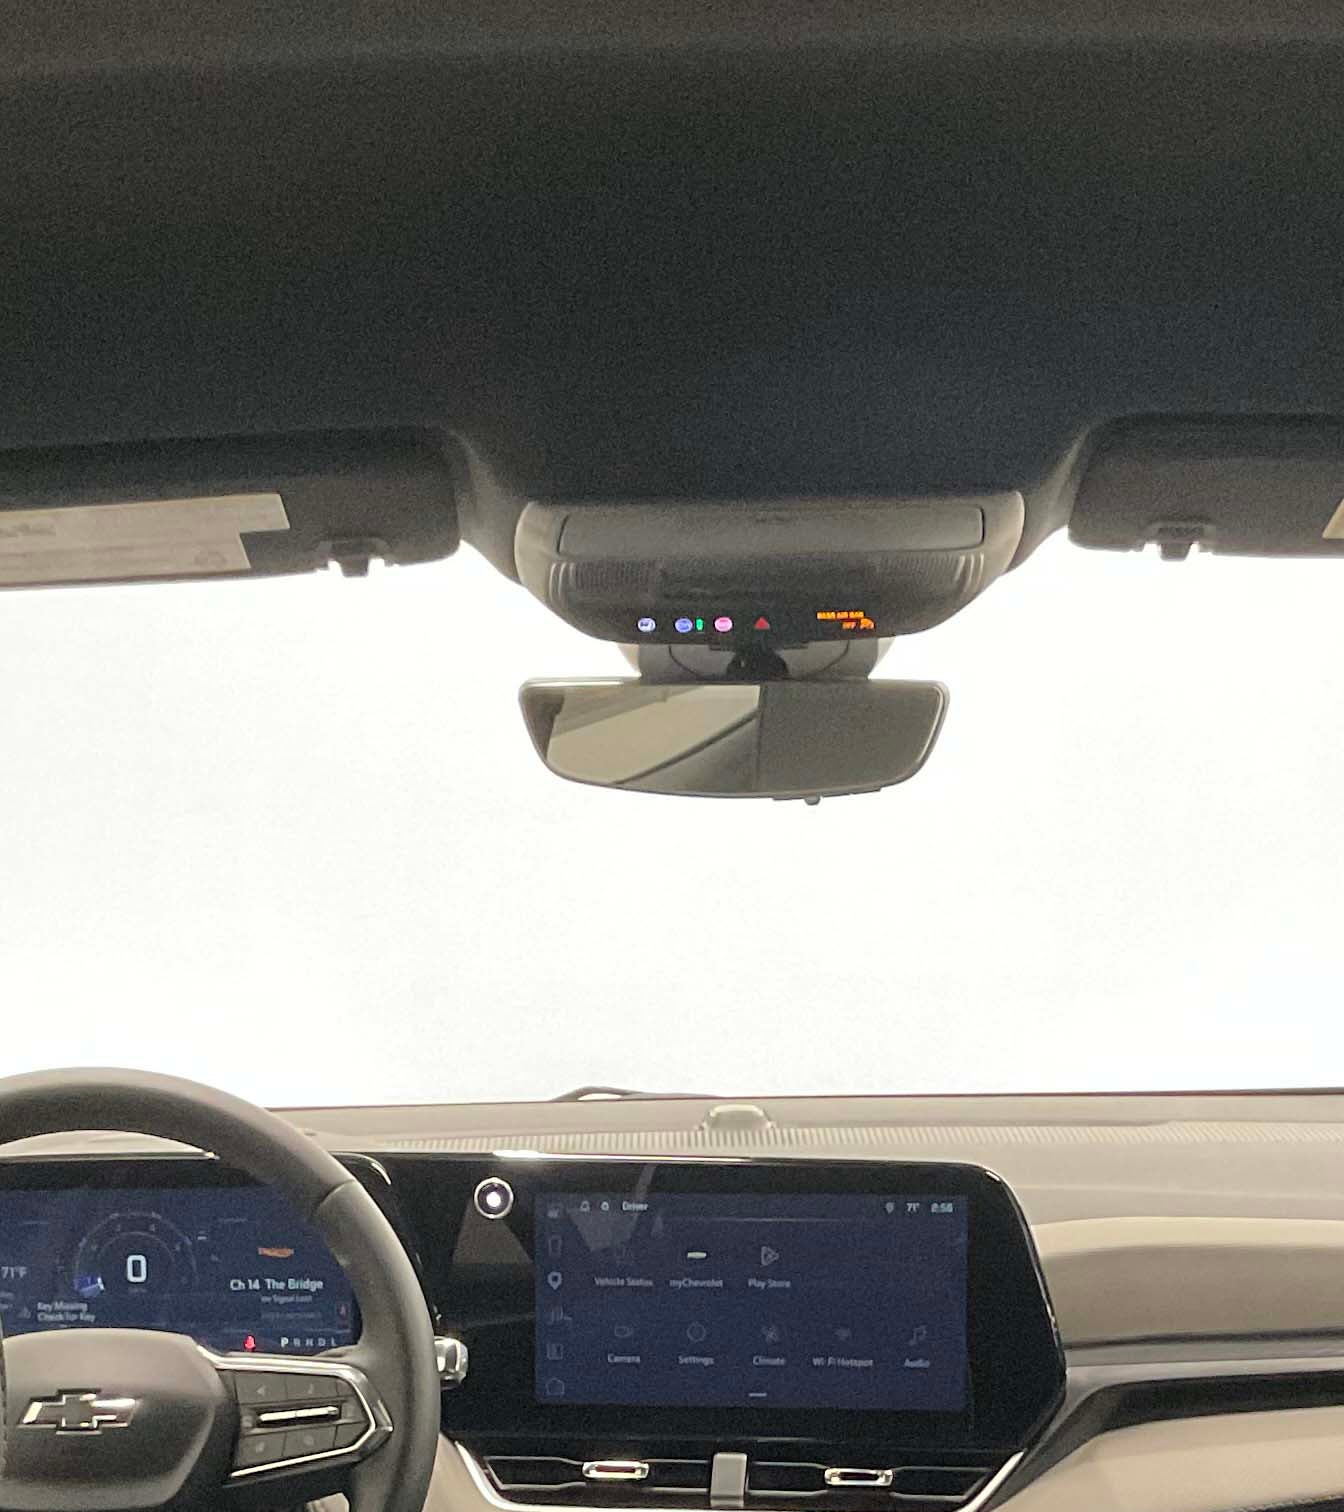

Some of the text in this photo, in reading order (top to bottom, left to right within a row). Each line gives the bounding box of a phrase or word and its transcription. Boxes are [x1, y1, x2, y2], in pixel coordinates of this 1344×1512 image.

[126, 1254, 147, 1283] 0
[230, 1279, 324, 1292] Ch 14 The Bridge
[281, 1337, 289, 1347] P
